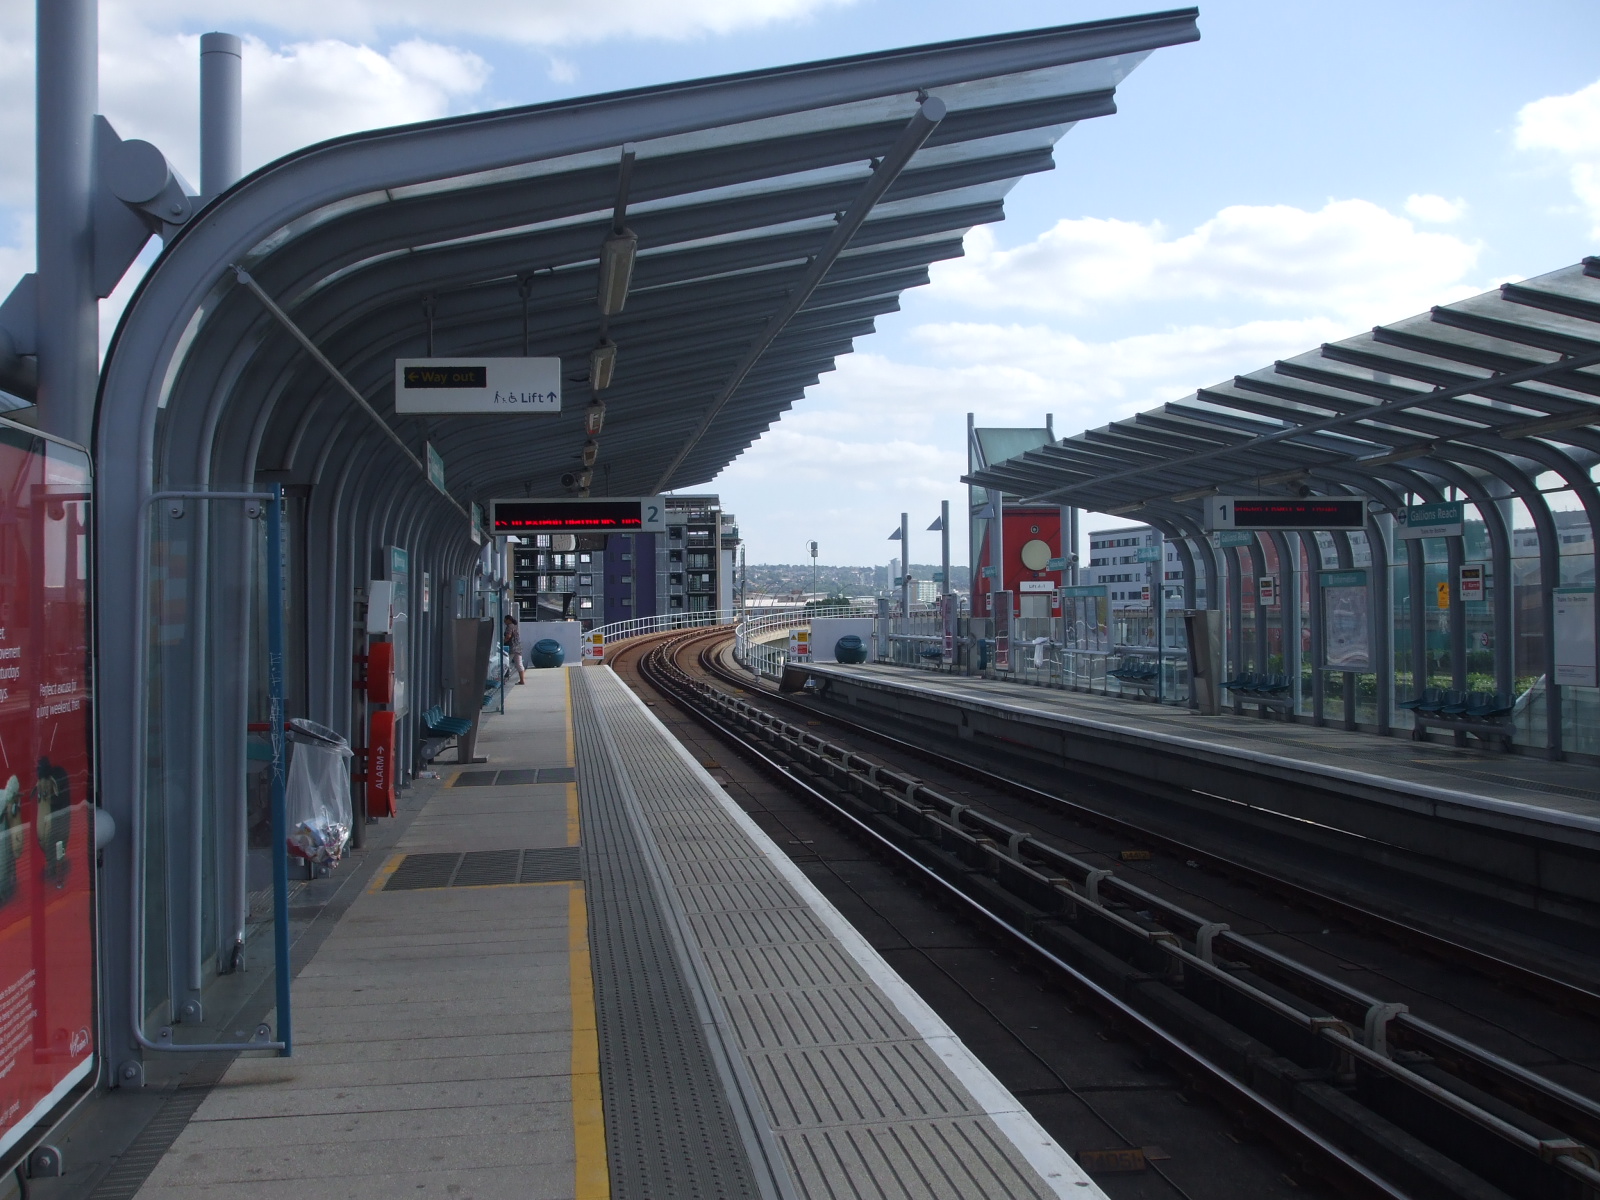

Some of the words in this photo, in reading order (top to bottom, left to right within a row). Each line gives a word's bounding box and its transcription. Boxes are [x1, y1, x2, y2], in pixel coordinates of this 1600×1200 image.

[421, 372, 447, 384] Way
[452, 372, 475, 382] out
[521, 393, 544, 403] Lift
[647, 506, 659, 520] 2
[1219, 504, 1227, 521] 1
[1410, 510, 1436, 522] Gallions
[1437, 507, 1457, 519] Reach
[375, 756, 384, 790] ALARM
